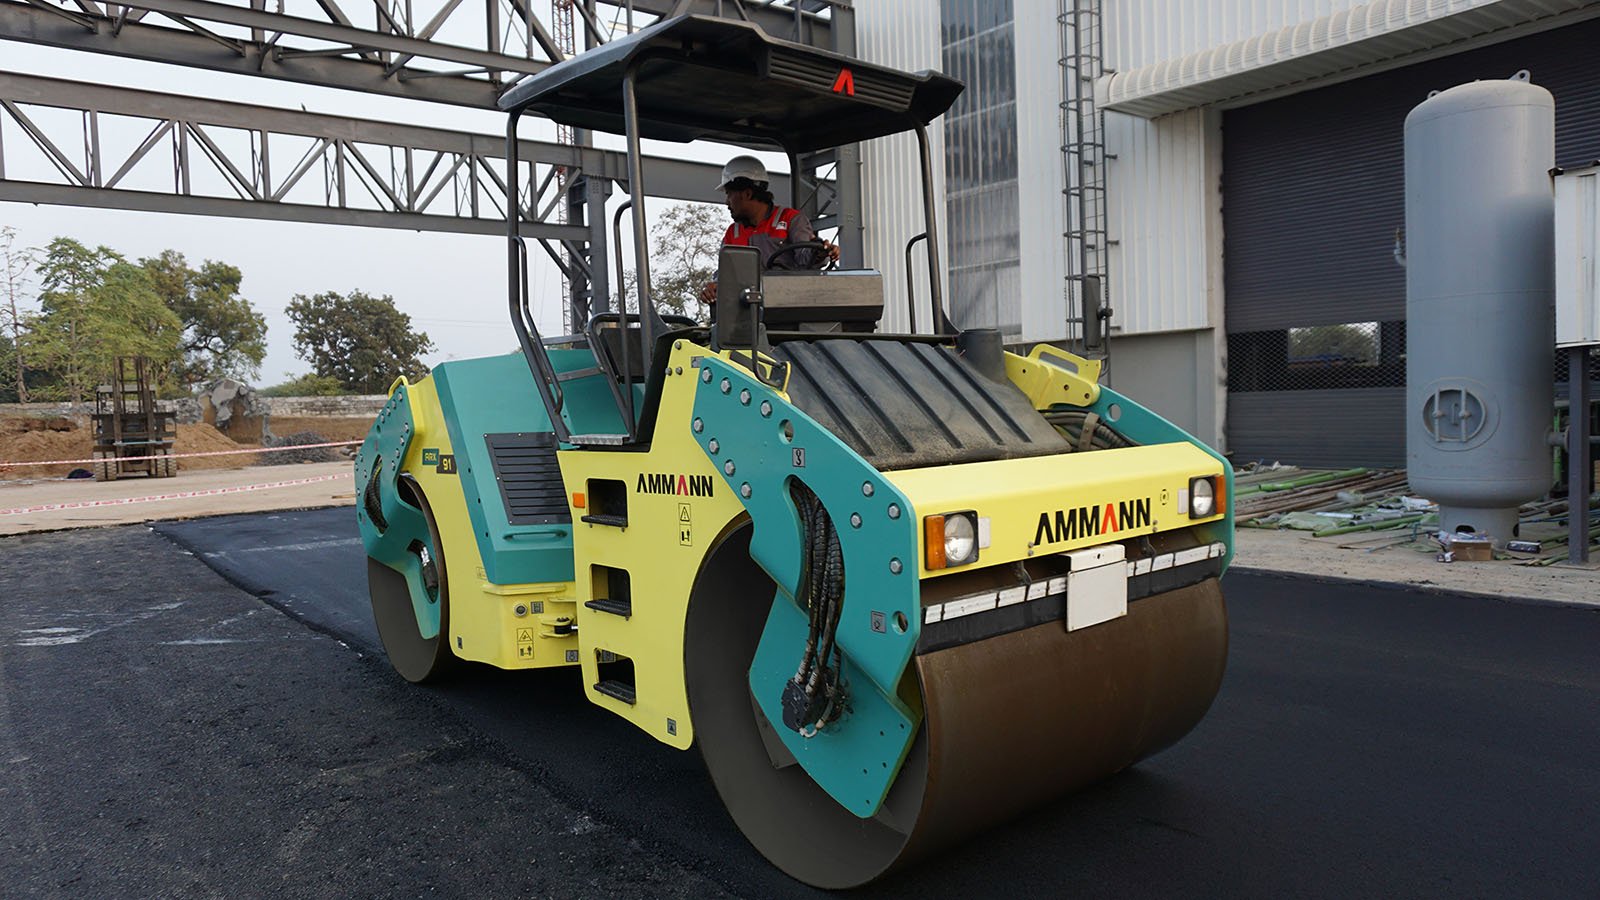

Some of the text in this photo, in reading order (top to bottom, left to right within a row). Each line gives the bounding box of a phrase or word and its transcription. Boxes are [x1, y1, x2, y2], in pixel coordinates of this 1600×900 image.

[442, 458, 452, 471] 91
[636, 473, 714, 497] AMMANN
[1034, 497, 1151, 546] AMMANN
